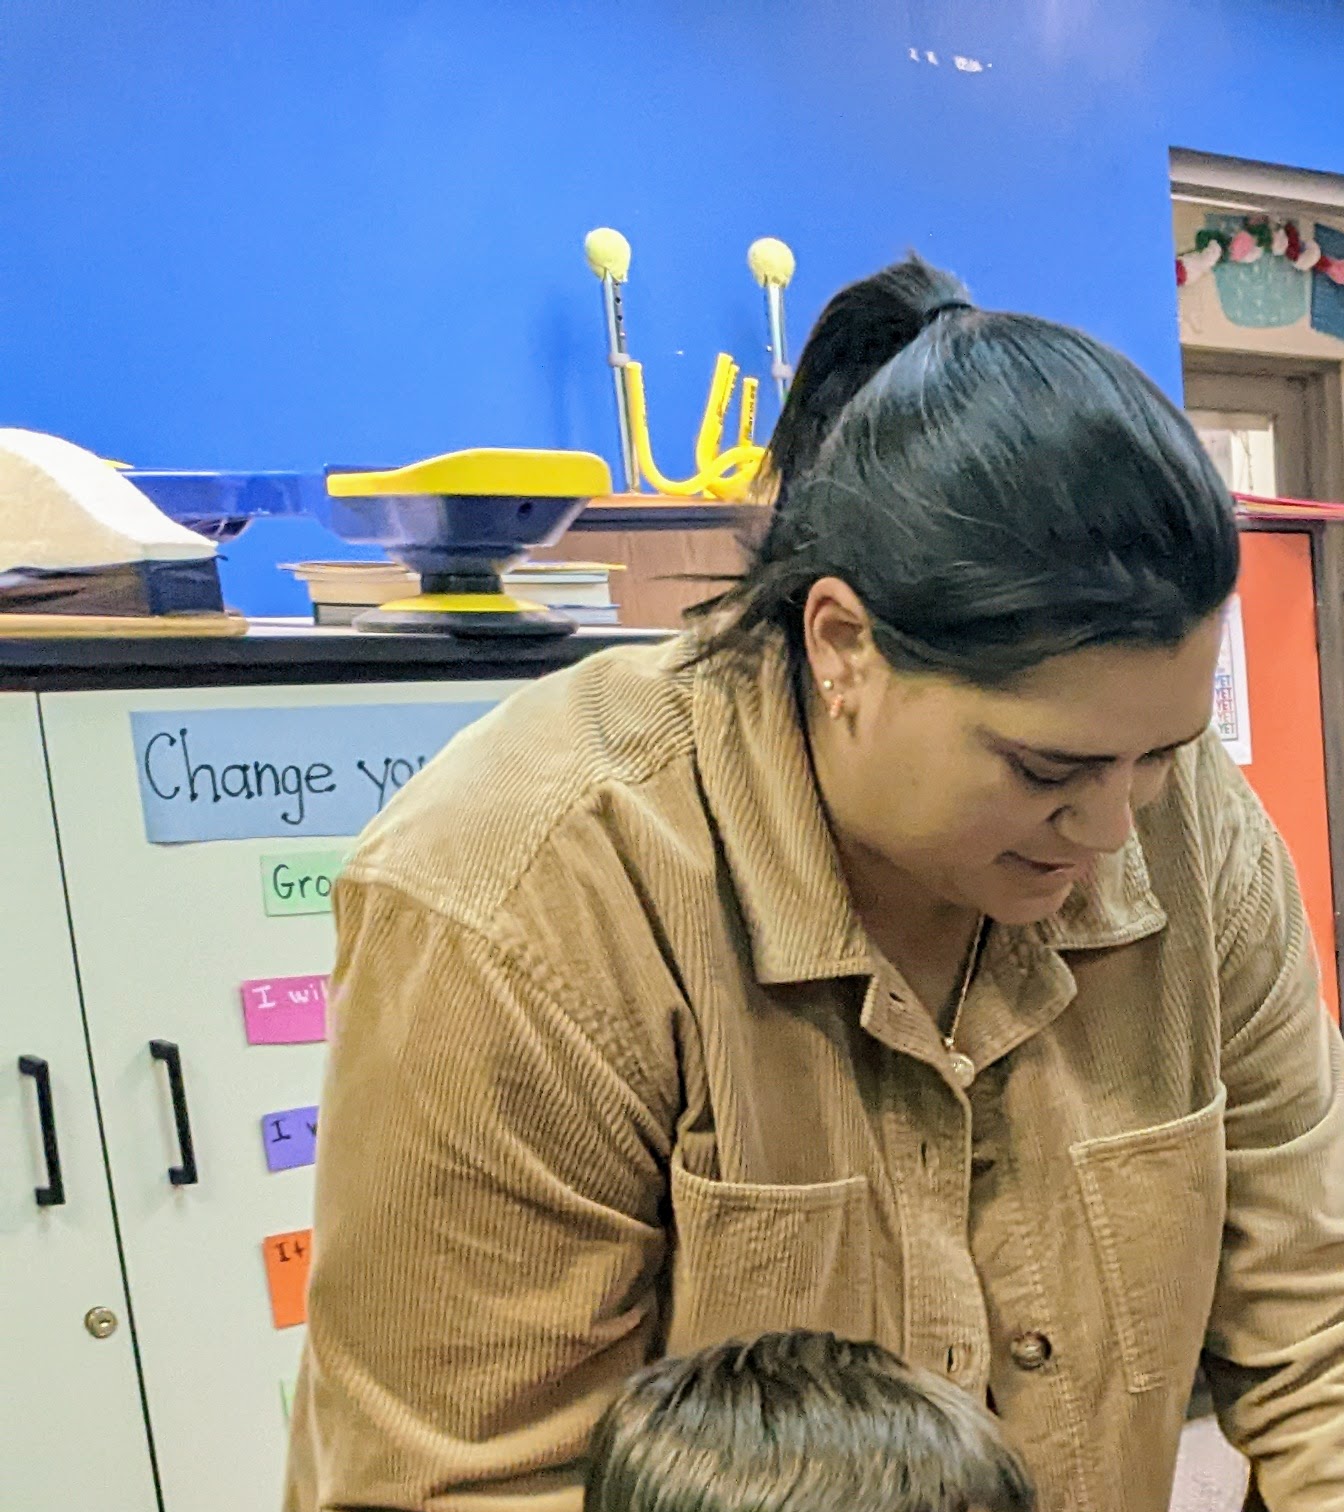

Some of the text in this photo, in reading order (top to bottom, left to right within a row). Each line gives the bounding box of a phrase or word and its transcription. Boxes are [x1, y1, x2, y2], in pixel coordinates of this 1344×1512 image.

[1216, 688, 1233, 700] YET
[1218, 722, 1235, 735] YET
[145, 727, 337, 825] Change
[252, 984, 276, 1009] I
[270, 1117, 292, 1143] I
